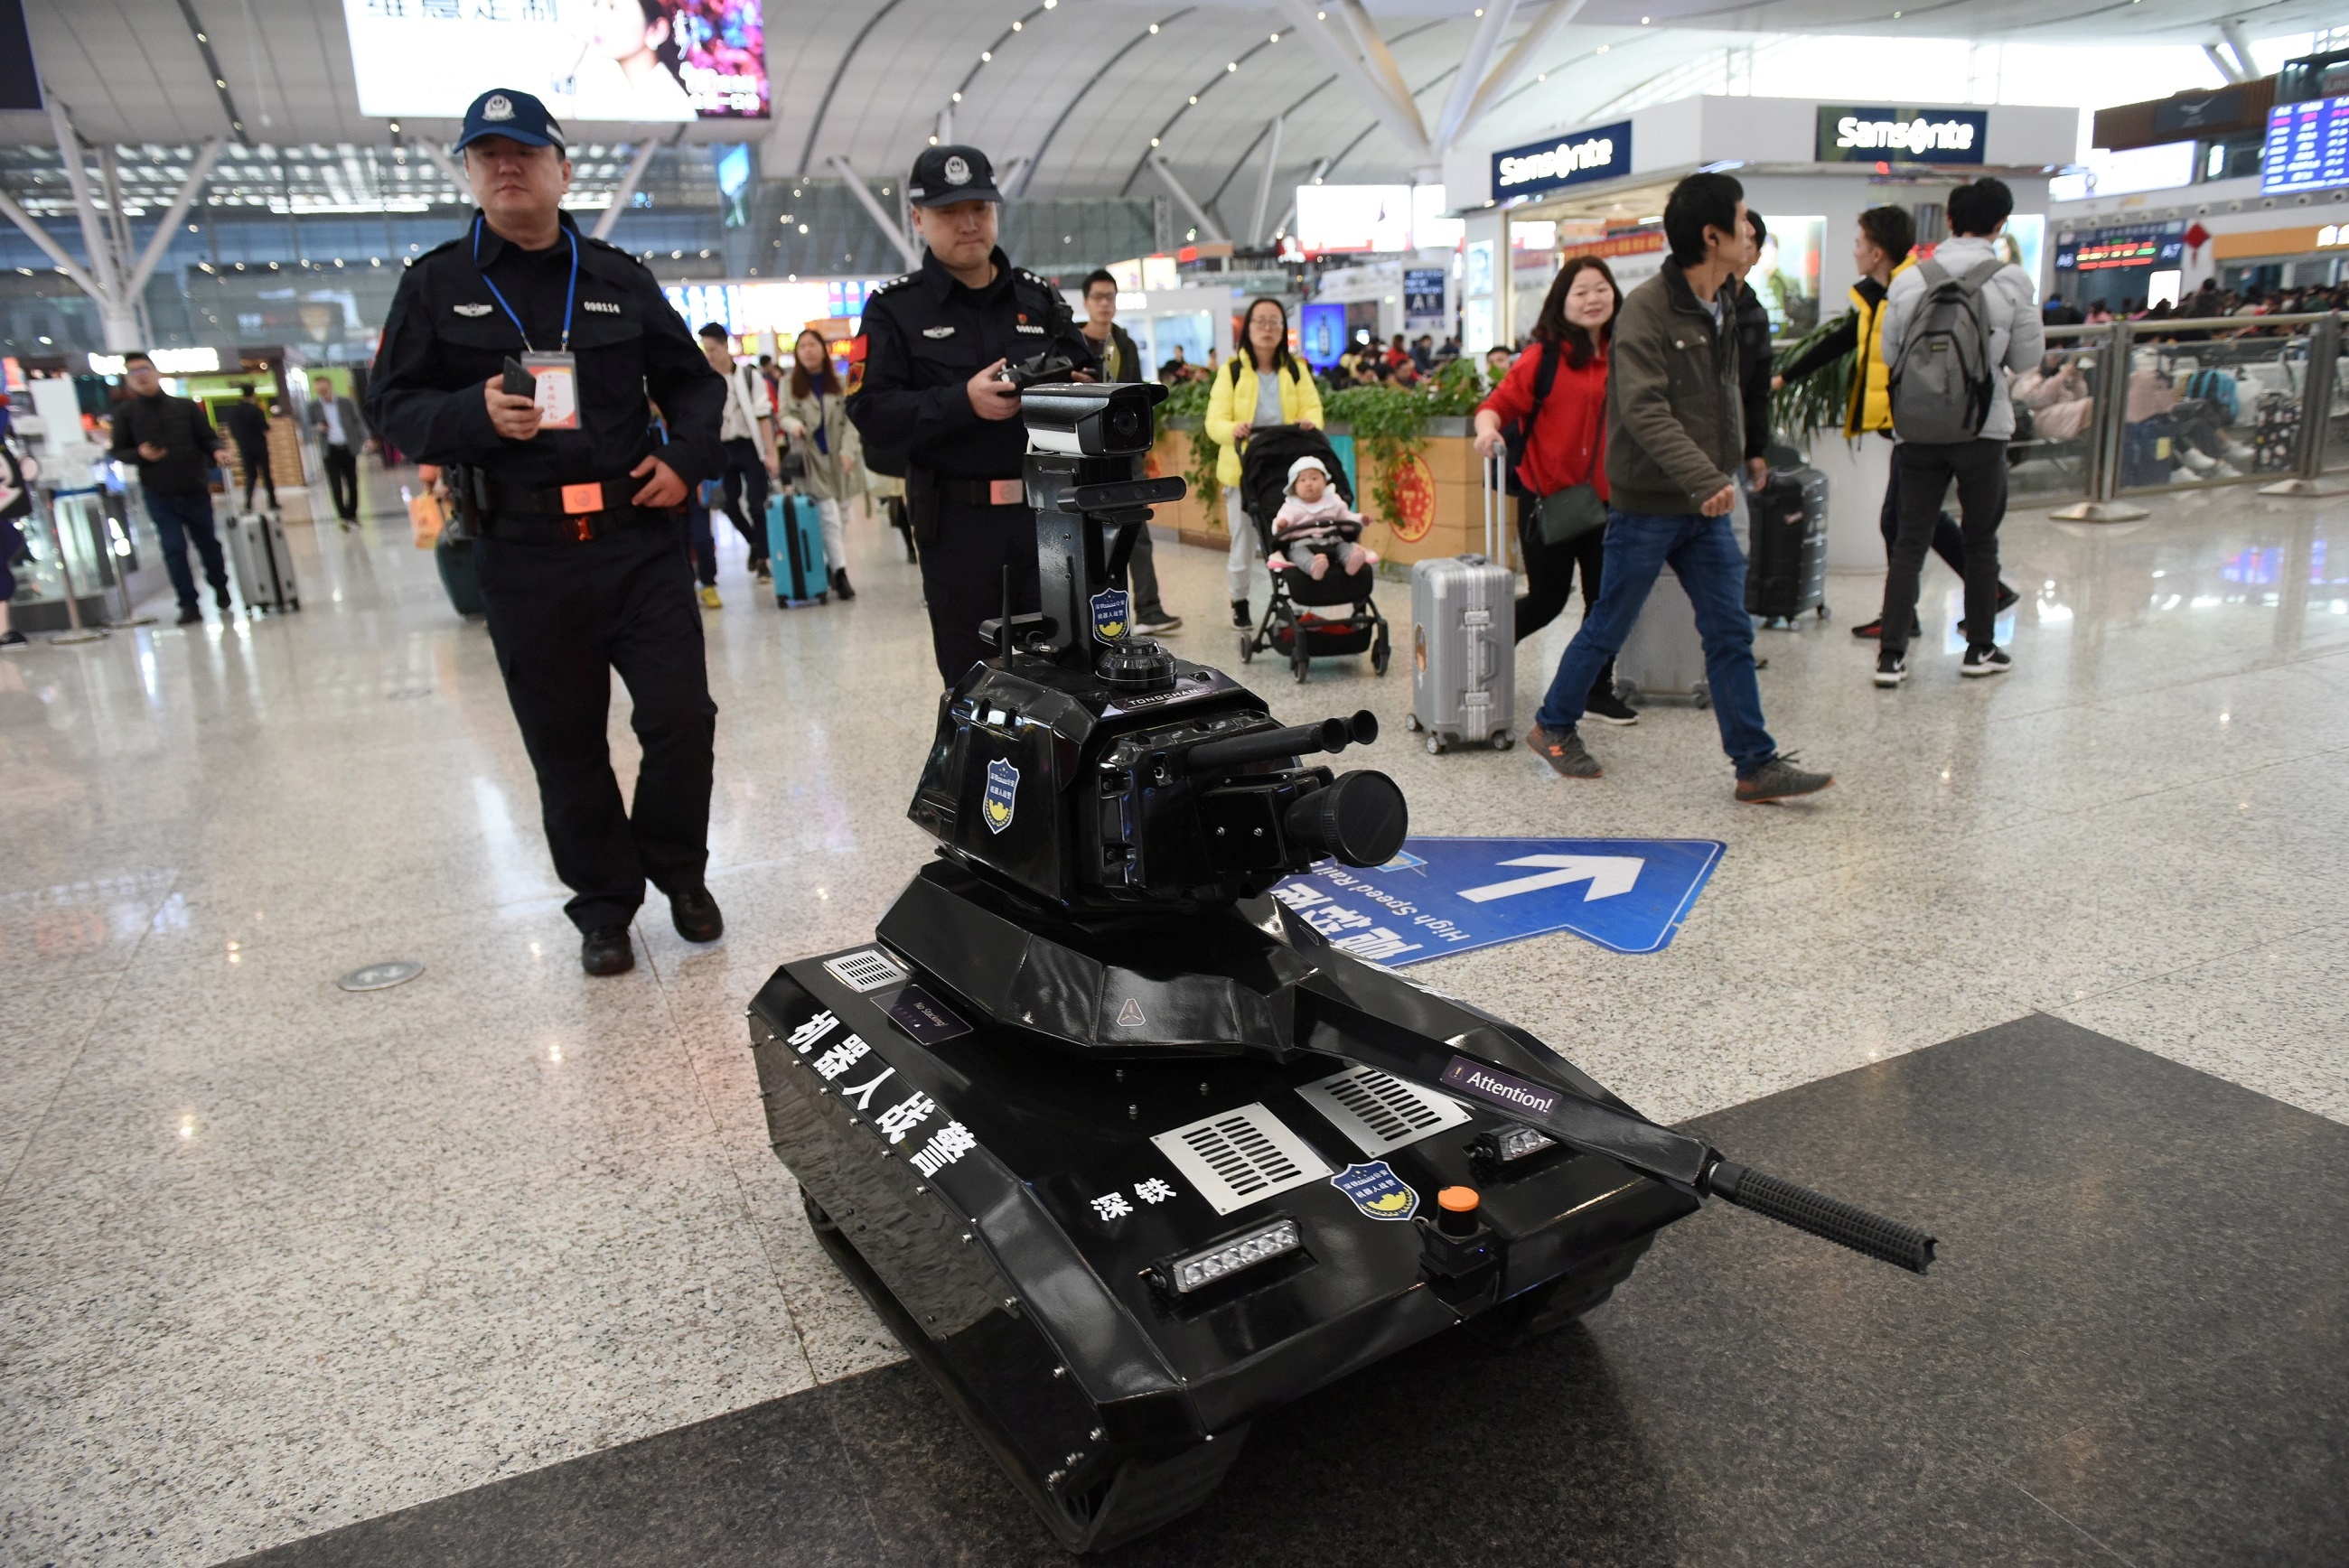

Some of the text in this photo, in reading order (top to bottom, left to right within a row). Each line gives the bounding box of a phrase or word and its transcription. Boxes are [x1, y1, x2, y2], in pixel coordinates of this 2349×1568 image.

[1128, 688, 1199, 705] TONGCHAN
[1312, 866, 1471, 942] High Speed Rail
[787, 1010, 978, 1178] 机器人战警
[1466, 1071, 1553, 1112] Attention!
